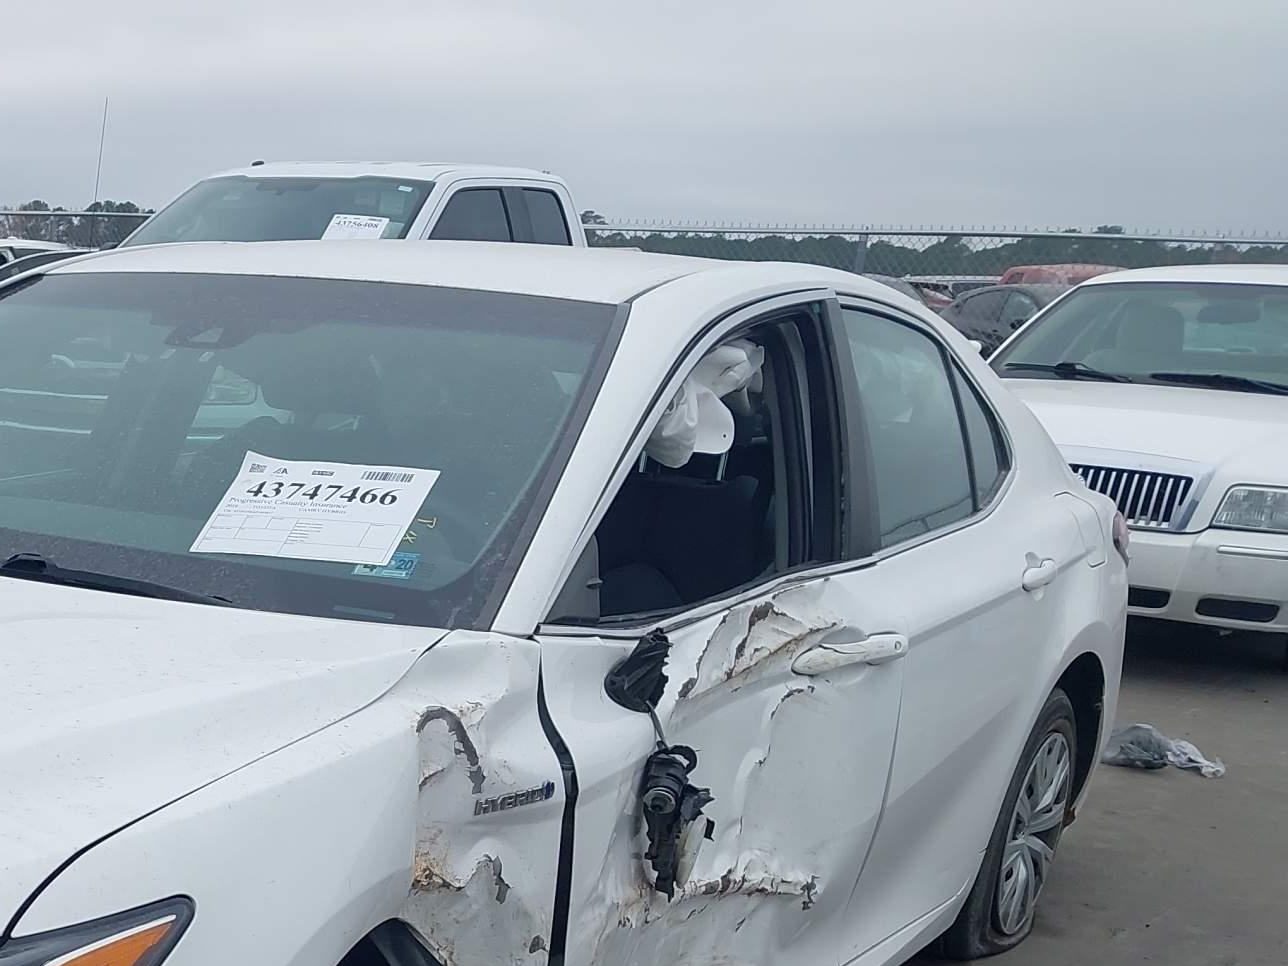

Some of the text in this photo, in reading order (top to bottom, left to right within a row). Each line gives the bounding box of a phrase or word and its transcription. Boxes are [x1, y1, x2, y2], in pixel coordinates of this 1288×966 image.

[246, 480, 403, 506] 43747466
[229, 497, 348, 510] Progressive Casualty Insurance
